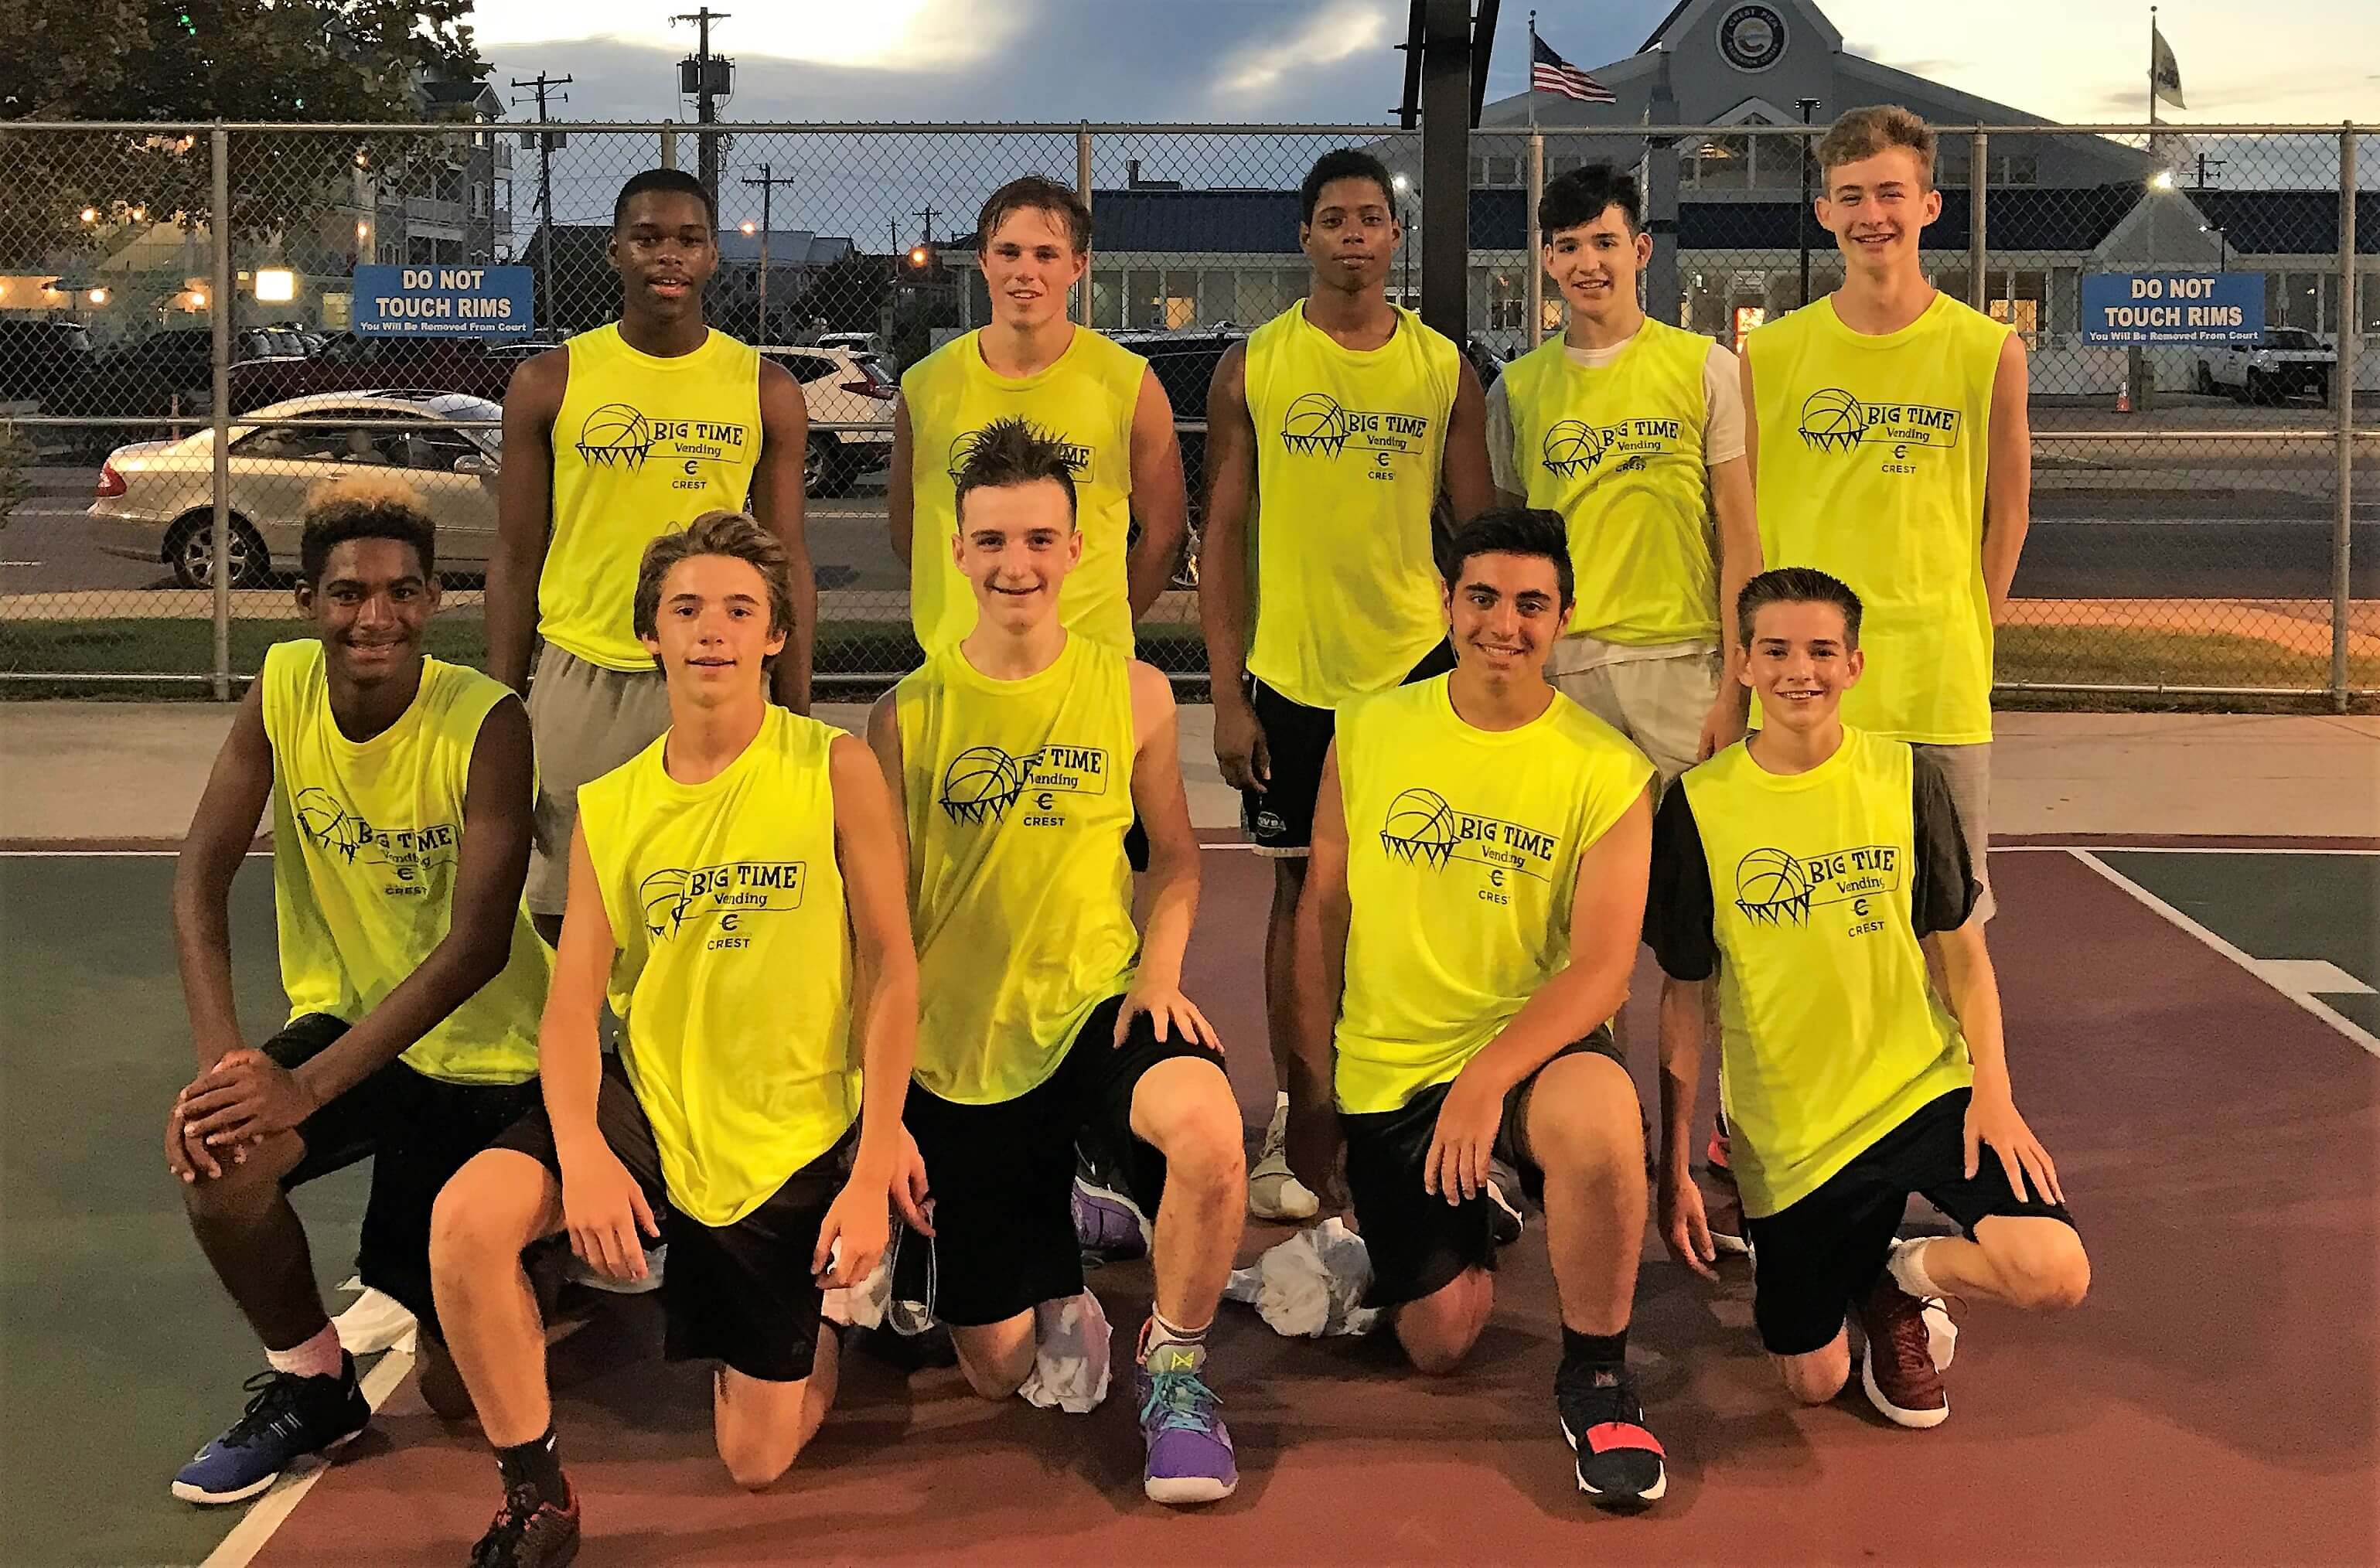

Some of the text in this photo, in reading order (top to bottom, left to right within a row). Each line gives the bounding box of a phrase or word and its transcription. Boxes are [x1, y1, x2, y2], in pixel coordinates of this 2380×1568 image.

[403, 270, 485, 290] DO NOT
[2132, 278, 2215, 298] DO NOT
[376, 298, 511, 318] TOUCH RIMS
[2104, 306, 2242, 327] TOUCH RIMS
[360, 322, 527, 332] You Will Be Removed From Court
[2089, 331, 2258, 341] You Will Be Removed From Court
[1349, 414, 1427, 438] BIG TIME
[1868, 407, 1954, 431] BIG TIME
[653, 423, 743, 446] BIG TIME
[1635, 421, 1679, 439] TIME
[1887, 427, 1930, 442] Vending
[675, 442, 721, 458] Vending
[1366, 435, 1407, 450] Vending
[1618, 441, 1661, 452] Vending
[1368, 471, 1394, 480] CRES
[1881, 465, 1917, 474] CREST
[672, 481, 708, 489] CREST
[1052, 748, 1101, 773] TIME
[1023, 817, 1066, 827] CREST
[397, 827, 452, 852] TME
[1460, 816, 1554, 861] BIG TIME
[1809, 856, 1846, 884] BIG
[690, 865, 797, 896] BIG TIME
[714, 892, 768, 908] Vending
[1478, 891, 1509, 905] CRES
[1848, 921, 1885, 938] CREST
[708, 939, 751, 950] CREST
